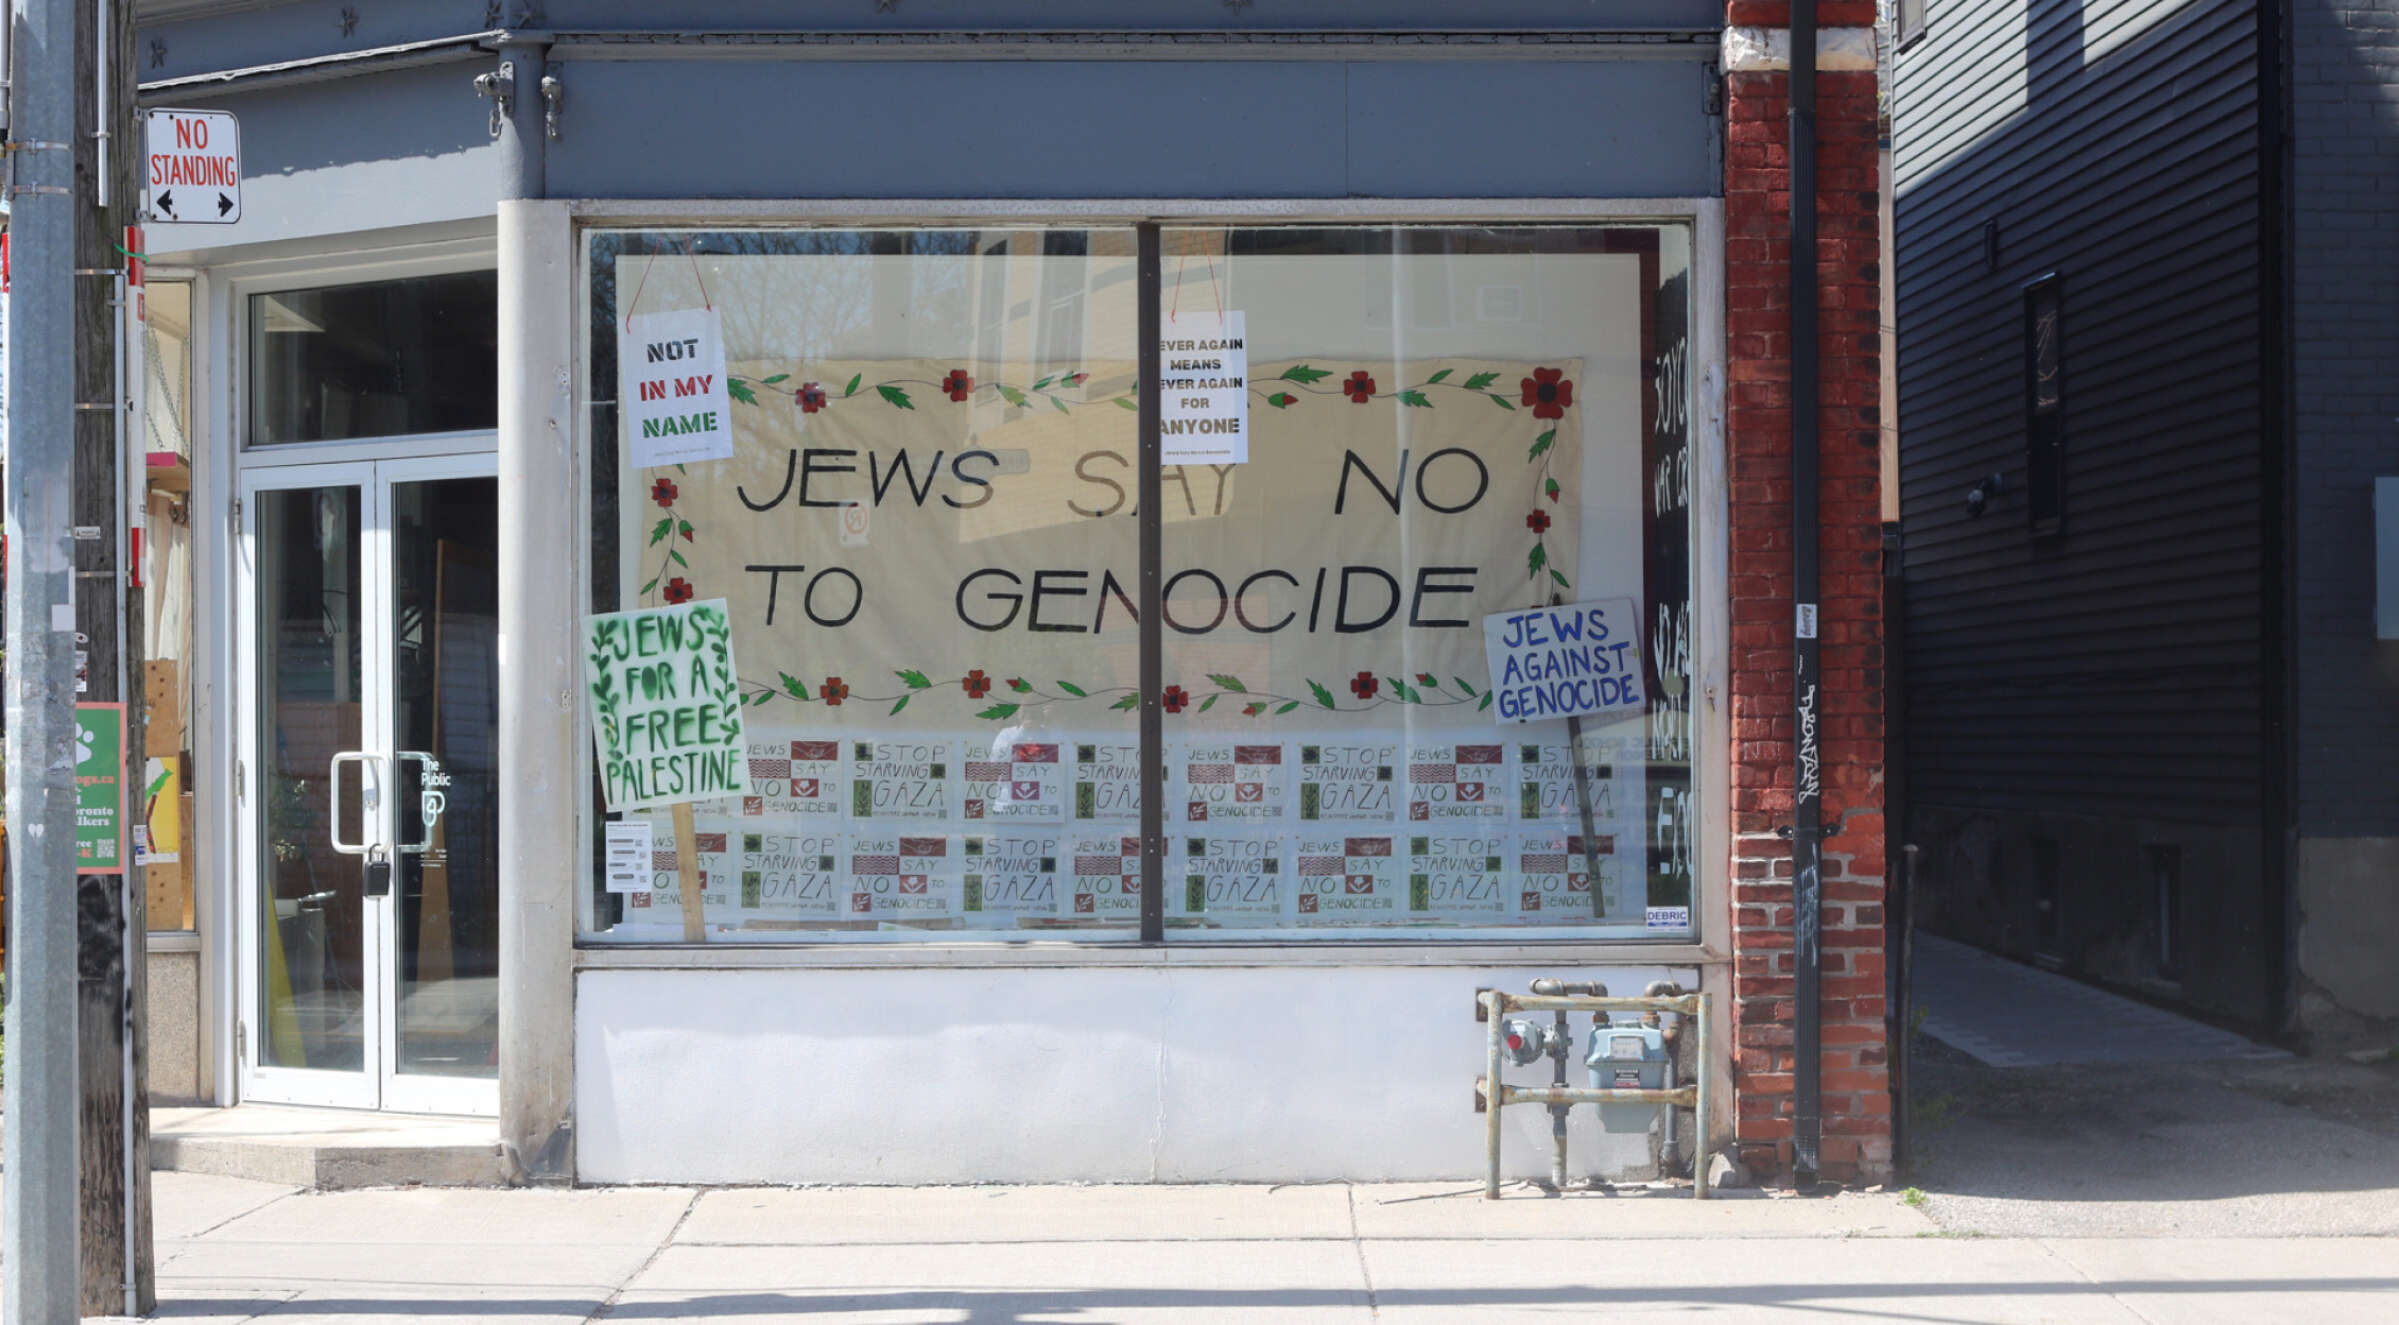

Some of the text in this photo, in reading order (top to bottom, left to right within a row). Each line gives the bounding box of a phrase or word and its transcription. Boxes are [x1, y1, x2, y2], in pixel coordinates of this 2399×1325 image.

[176, 119, 208, 149] NO
[151, 154, 236, 187] STANDING
[647, 338, 698, 363] NOT
[1160, 338, 1243, 351] EVER AGAIN
[1170, 359, 1222, 370] MEANS
[640, 374, 713, 401] IN MY
[1160, 377, 1243, 389] EVER AGAIN
[1181, 398, 1210, 409] FOR
[643, 411, 718, 438] NAME
[1160, 418, 1240, 435] ANYONE
[737, 449, 1000, 512] JEWS
[1334, 447, 1489, 515] NO
[745, 565, 1478, 635] TO GENOCIDE
[614, 610, 705, 661] JEWS
[1503, 609, 1609, 648] JEWS
[1503, 641, 1630, 685] AGAINST
[626, 654, 710, 704] FOR A
[1500, 674, 1640, 718] GENOCIDE
[626, 704, 721, 754] FREE
[747, 744, 785, 755] JEWS
[878, 744, 945, 761] STOP
[1188, 749, 1230, 761] JEWS
[1323, 747, 1392, 764] STOP
[1411, 748, 1450, 760] JEWS
[421, 758, 439, 771] The
[796, 763, 831, 774] SAY
[856, 763, 929, 777] STARVING
[1016, 766, 1049, 777] SAY
[421, 772, 451, 786] Public
[606, 750, 740, 804] PALESTINE
[1078, 765, 1141, 780] STARVIN
[1239, 767, 1273, 779] SAY
[1304, 766, 1376, 780] STARVING
[1460, 767, 1493, 779] SAY
[823, 783, 836, 792] TO
[874, 780, 944, 807] GAZA
[1044, 786, 1057, 795] TO
[1190, 785, 1280, 801] NO TO
[1413, 785, 1500, 801] NO TO
[1321, 783, 1391, 809] GAZA
[764, 801, 827, 812] GENOCIDE
[1208, 806, 1272, 817] GENOCIDE
[1429, 805, 1495, 817] GENOCIDE
[652, 836, 675, 847] WS
[766, 836, 834, 853] STOP
[853, 840, 895, 851] JEWS
[987, 839, 1056, 855] STOP
[1076, 841, 1116, 852] JEWS
[1210, 840, 1278, 856] STOP
[1299, 842, 1340, 853] JEWS
[1432, 839, 1501, 855] STOP
[1522, 840, 1562, 850] JEWS
[744, 854, 817, 869] STARVING
[904, 859, 938, 870] SAY
[965, 857, 1039, 872] STARVING
[1188, 859, 1261, 873] STARVING
[1350, 860, 1384, 872] SAY
[1411, 857, 1484, 872] STARVING
[711, 874, 725, 884] TO
[762, 872, 832, 899] GAZA
[854, 876, 944, 893] NO TO
[1076, 877, 1112, 893] NO
[1301, 877, 1390, 893] NO TO
[1430, 874, 1500, 899] GAZA
[1523, 875, 1559, 892] NO
[984, 875, 1054, 901] GAZA
[1207, 875, 1276, 902] GAZA
[871, 898, 936, 909] GENOCIDE
[1095, 898, 1140, 909] GENOCI
[1318, 897, 1381, 909] GENOCIDE
[1648, 911, 1687, 920] DEBRIC
